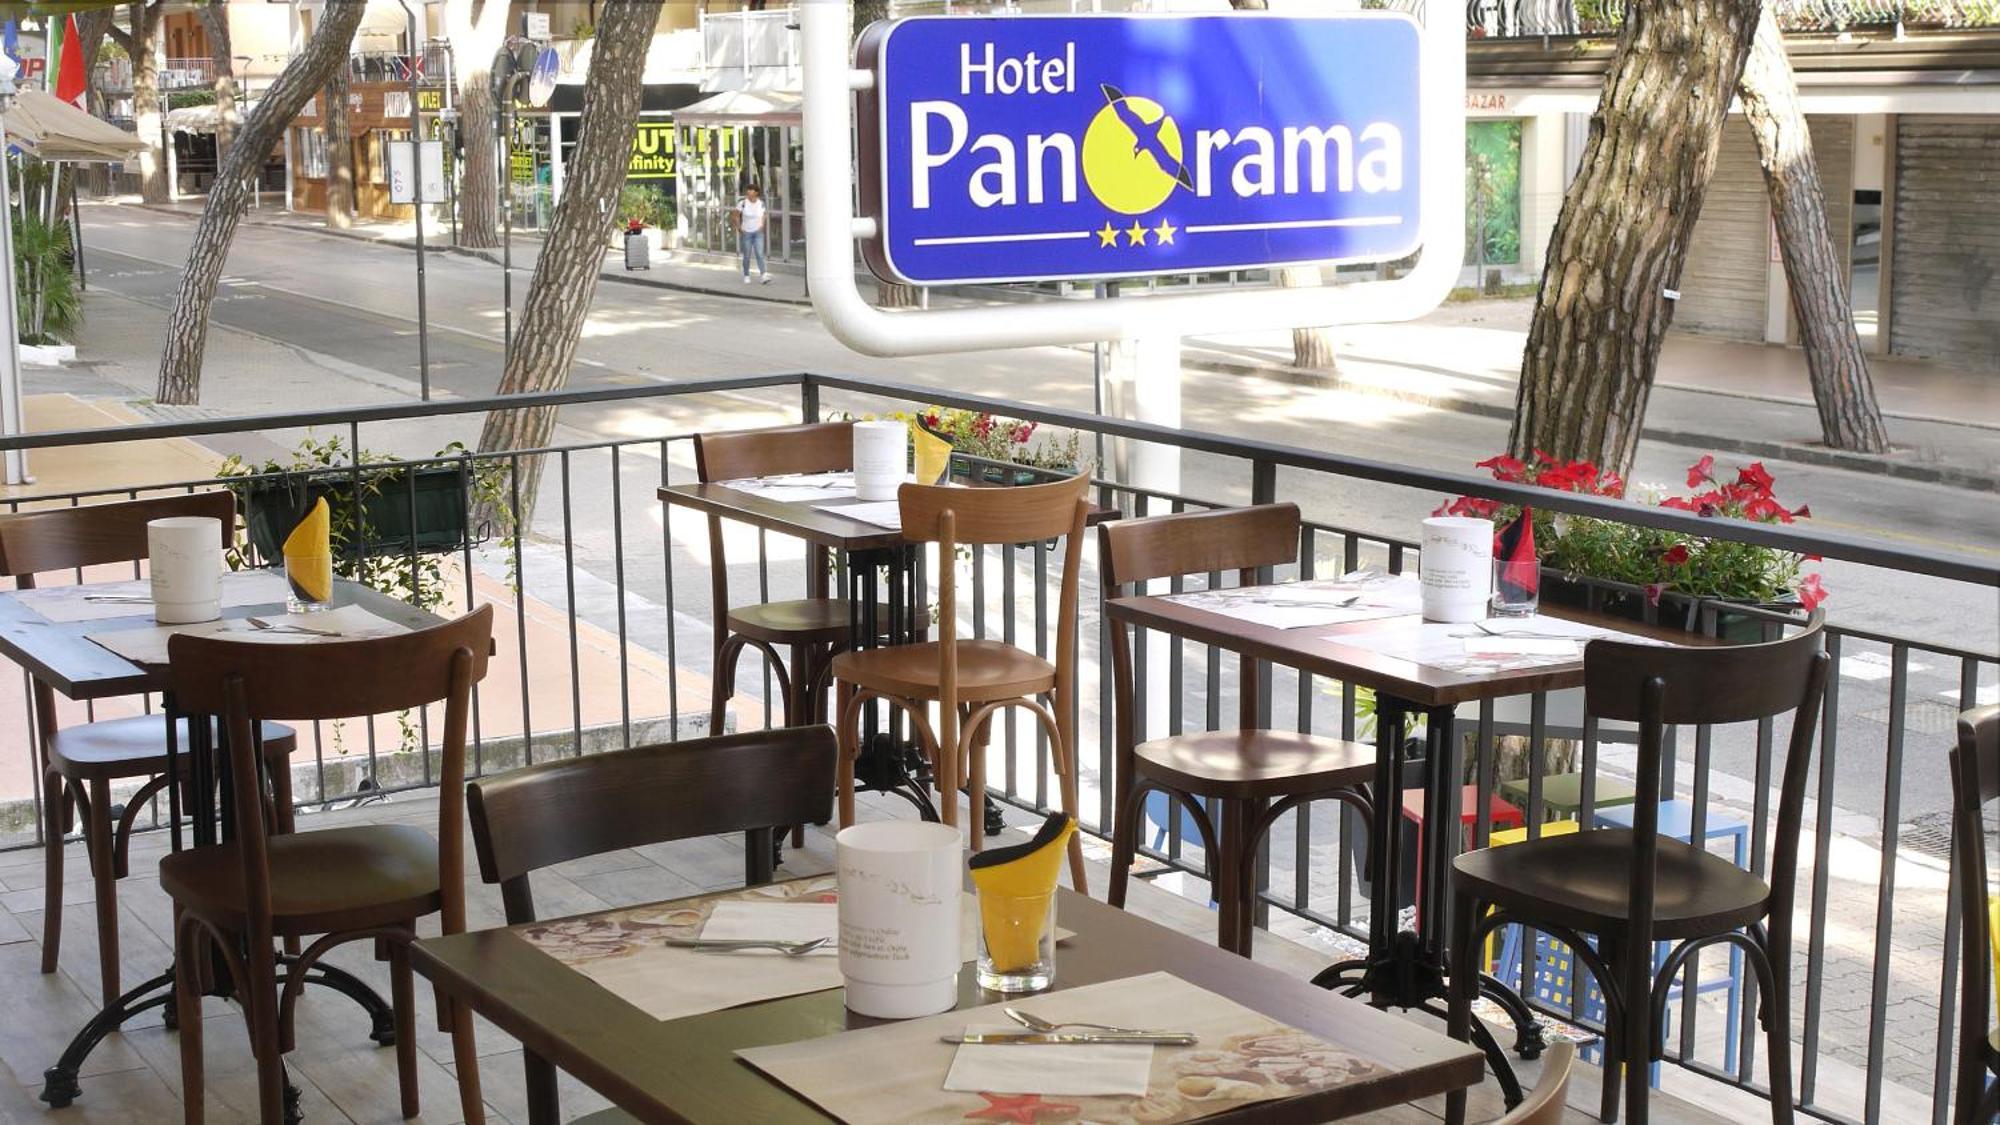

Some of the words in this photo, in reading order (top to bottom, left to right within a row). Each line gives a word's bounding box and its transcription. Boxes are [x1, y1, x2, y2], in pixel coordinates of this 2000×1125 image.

[960, 42, 1076, 96] Hotel
[632, 128, 736, 155] UTLET
[910, 98, 1404, 215] Panorama
